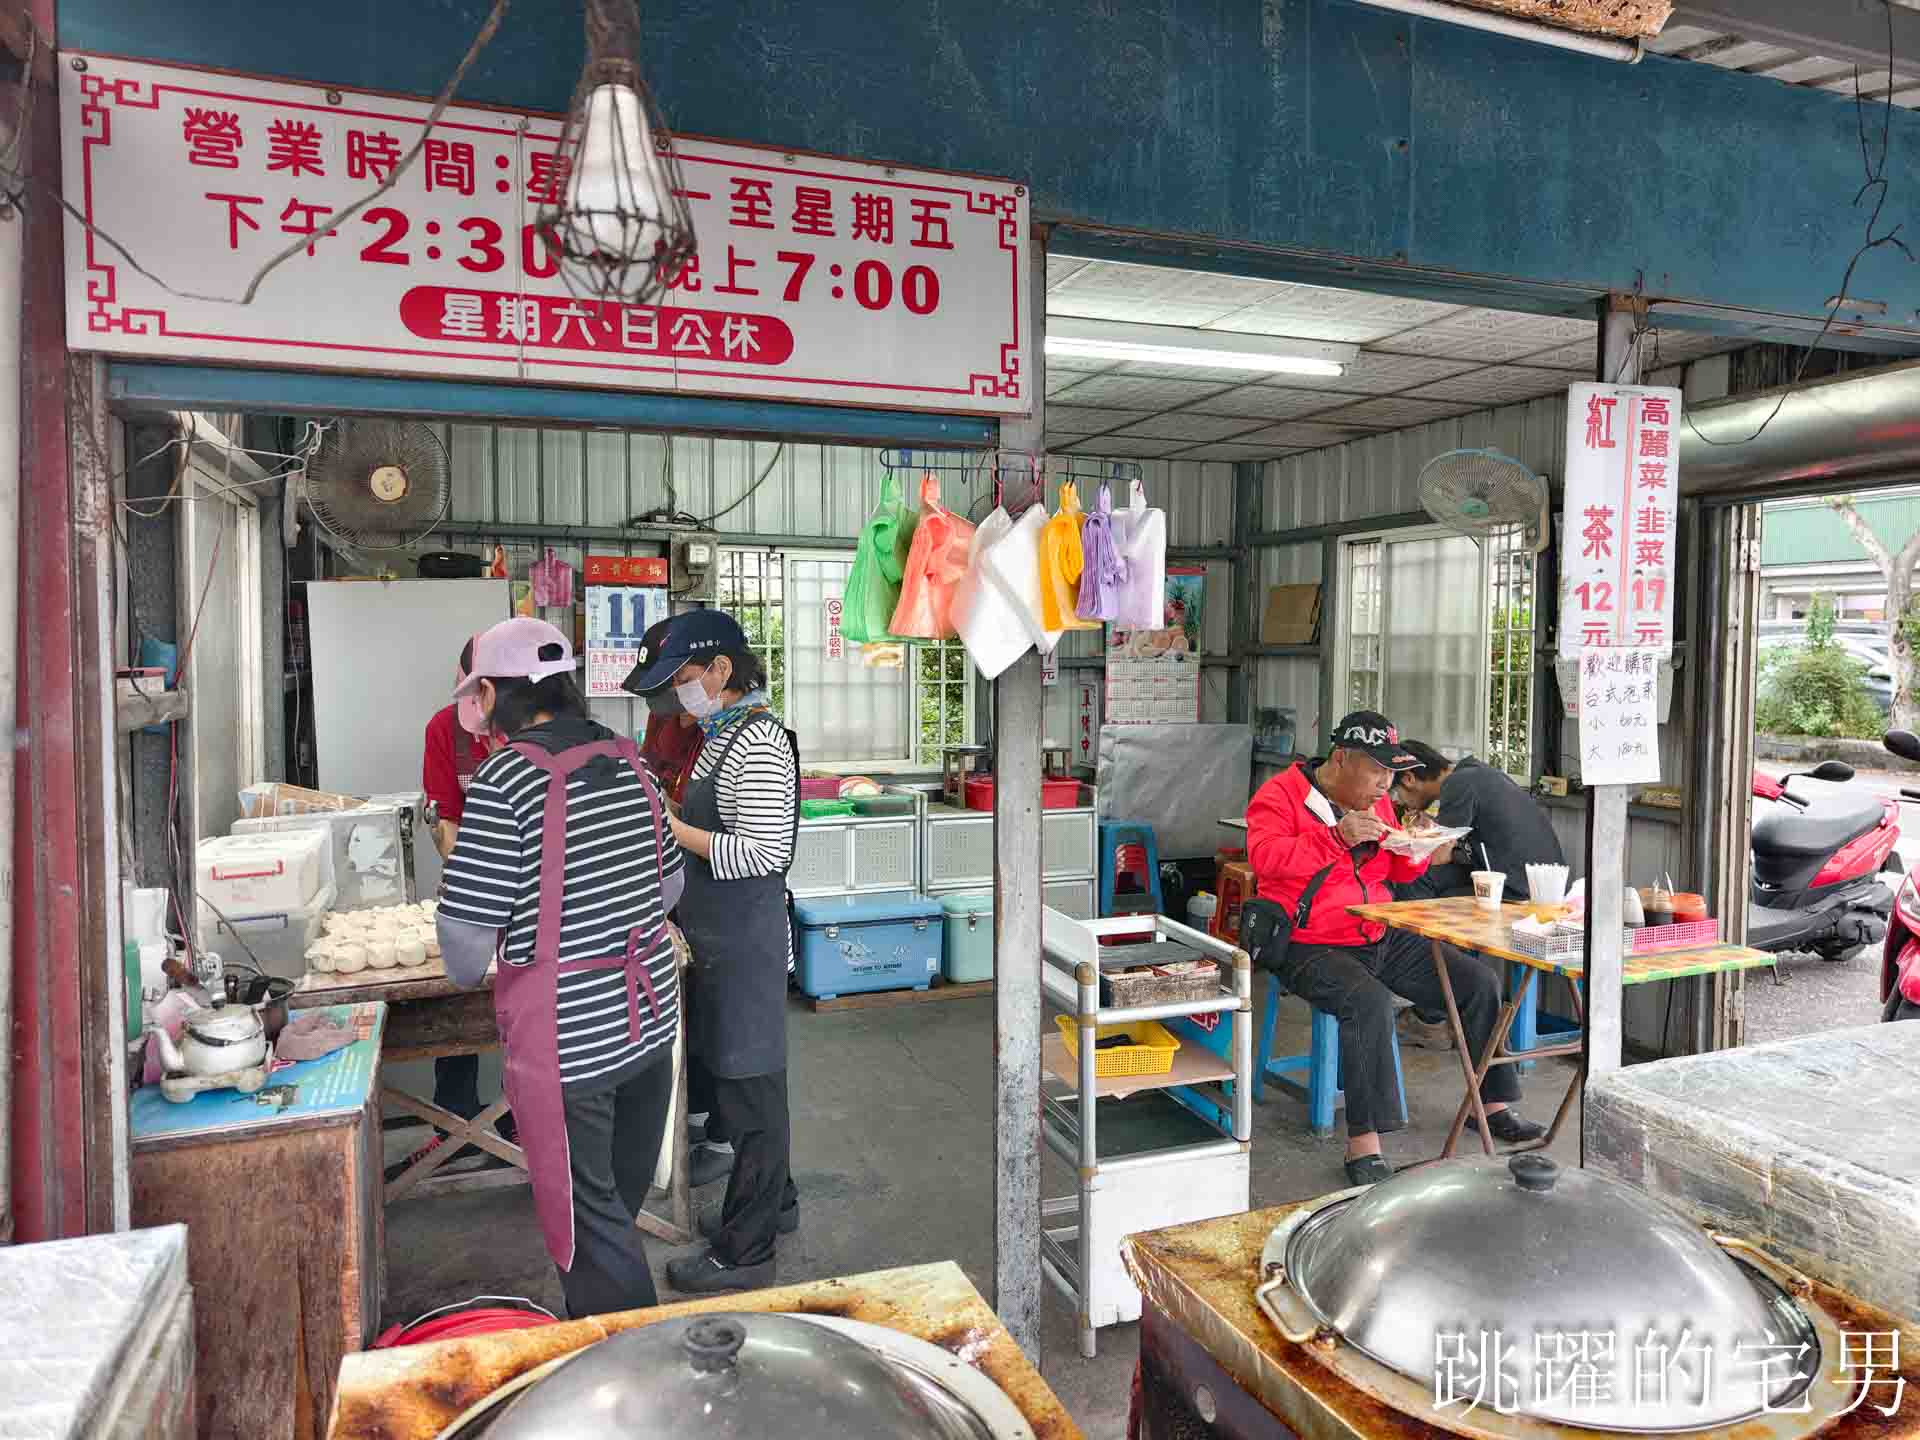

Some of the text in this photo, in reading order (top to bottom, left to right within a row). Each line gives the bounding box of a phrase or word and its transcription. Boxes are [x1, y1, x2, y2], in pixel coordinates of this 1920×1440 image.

[183, 107, 954, 250] 營業時間:星一至星期五
[605, 593, 645, 638] 11
